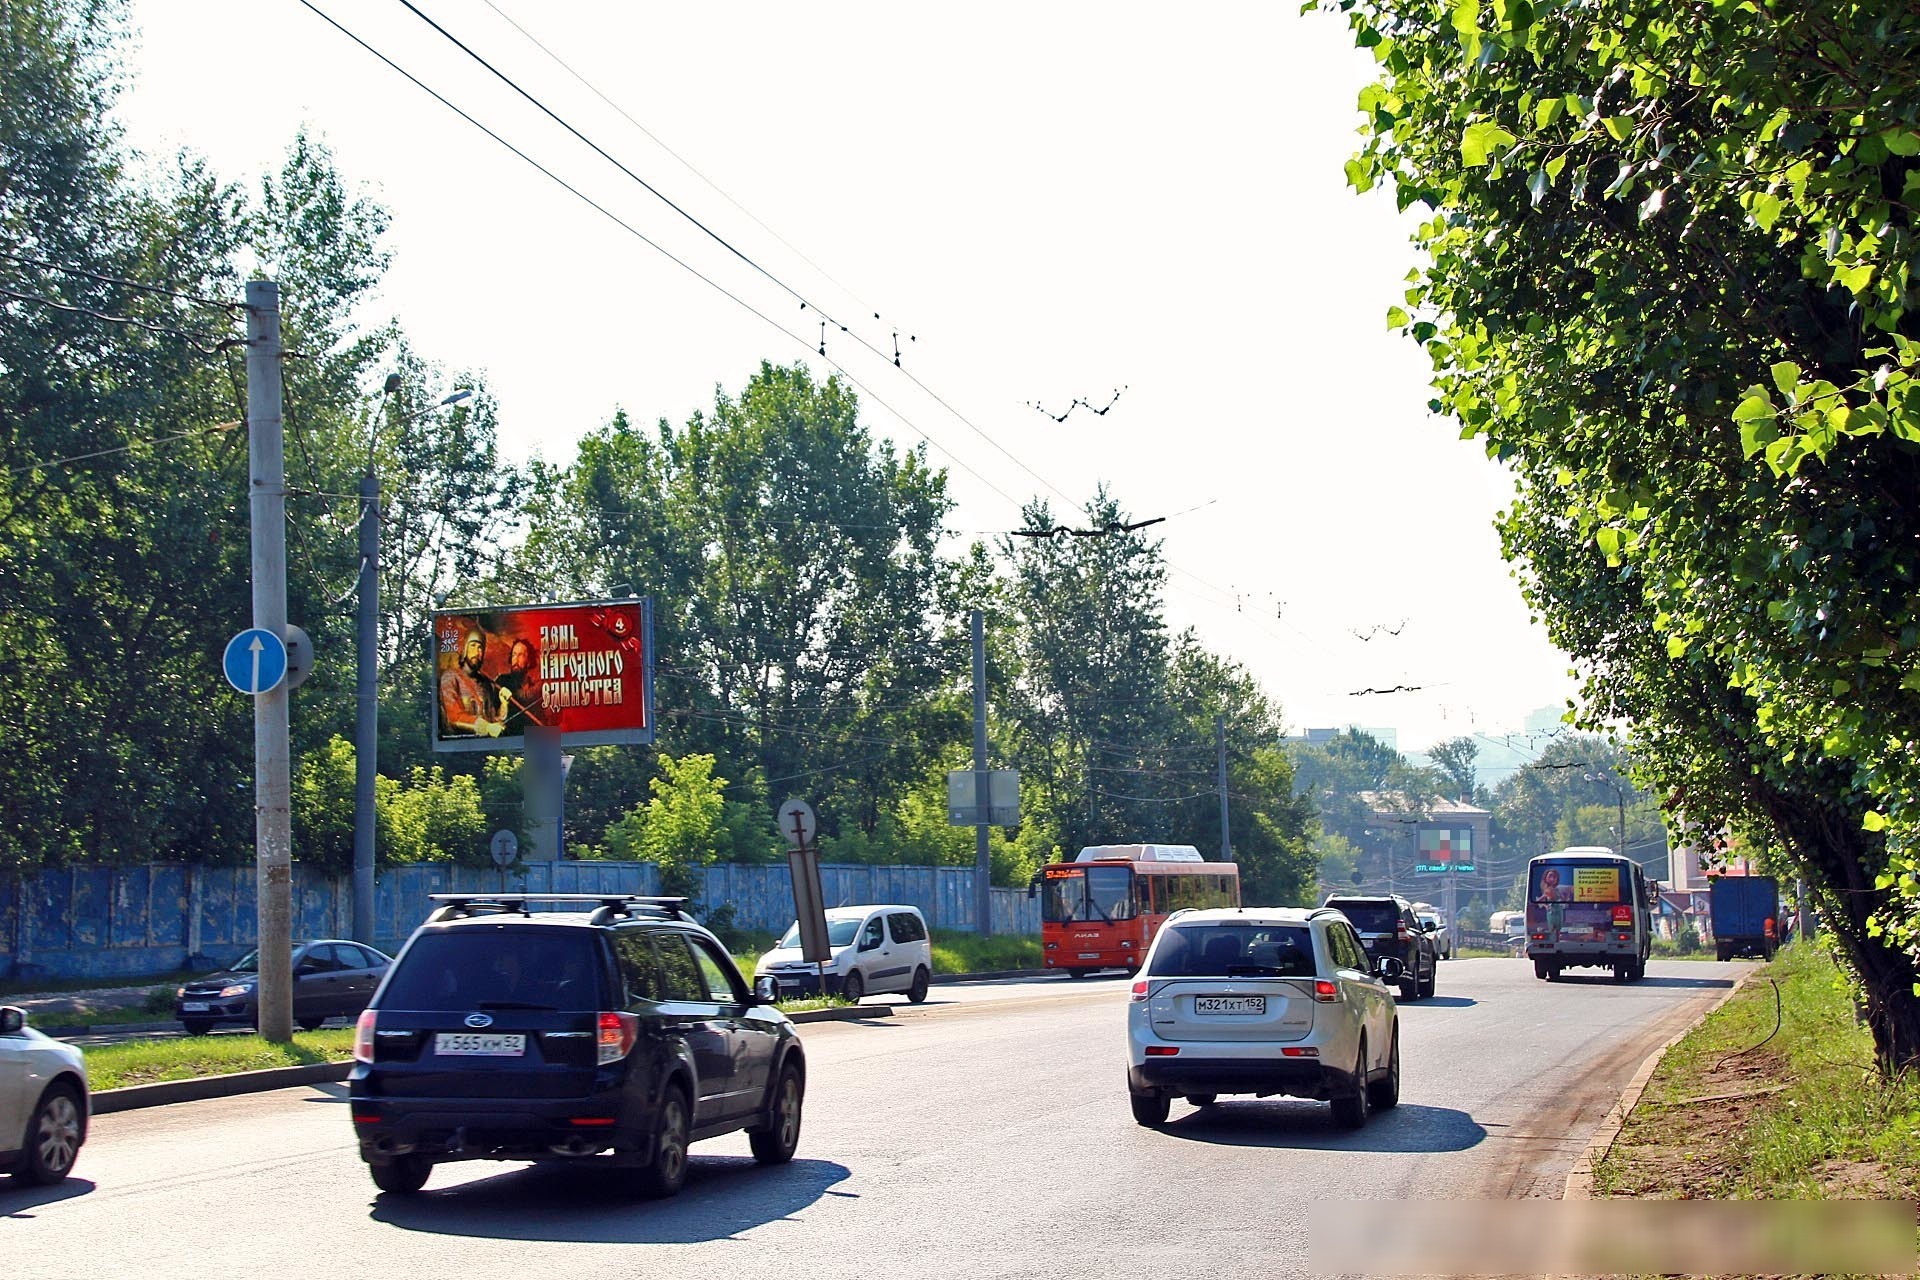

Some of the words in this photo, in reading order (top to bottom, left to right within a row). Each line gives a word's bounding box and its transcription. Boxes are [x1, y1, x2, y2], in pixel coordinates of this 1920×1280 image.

[540, 624, 579, 651] ДЕНЬ
[615, 617, 625, 630] 4
[540, 650, 624, 681] НАРОДНОГО
[541, 677, 623, 712] ЕДИНСТВА
